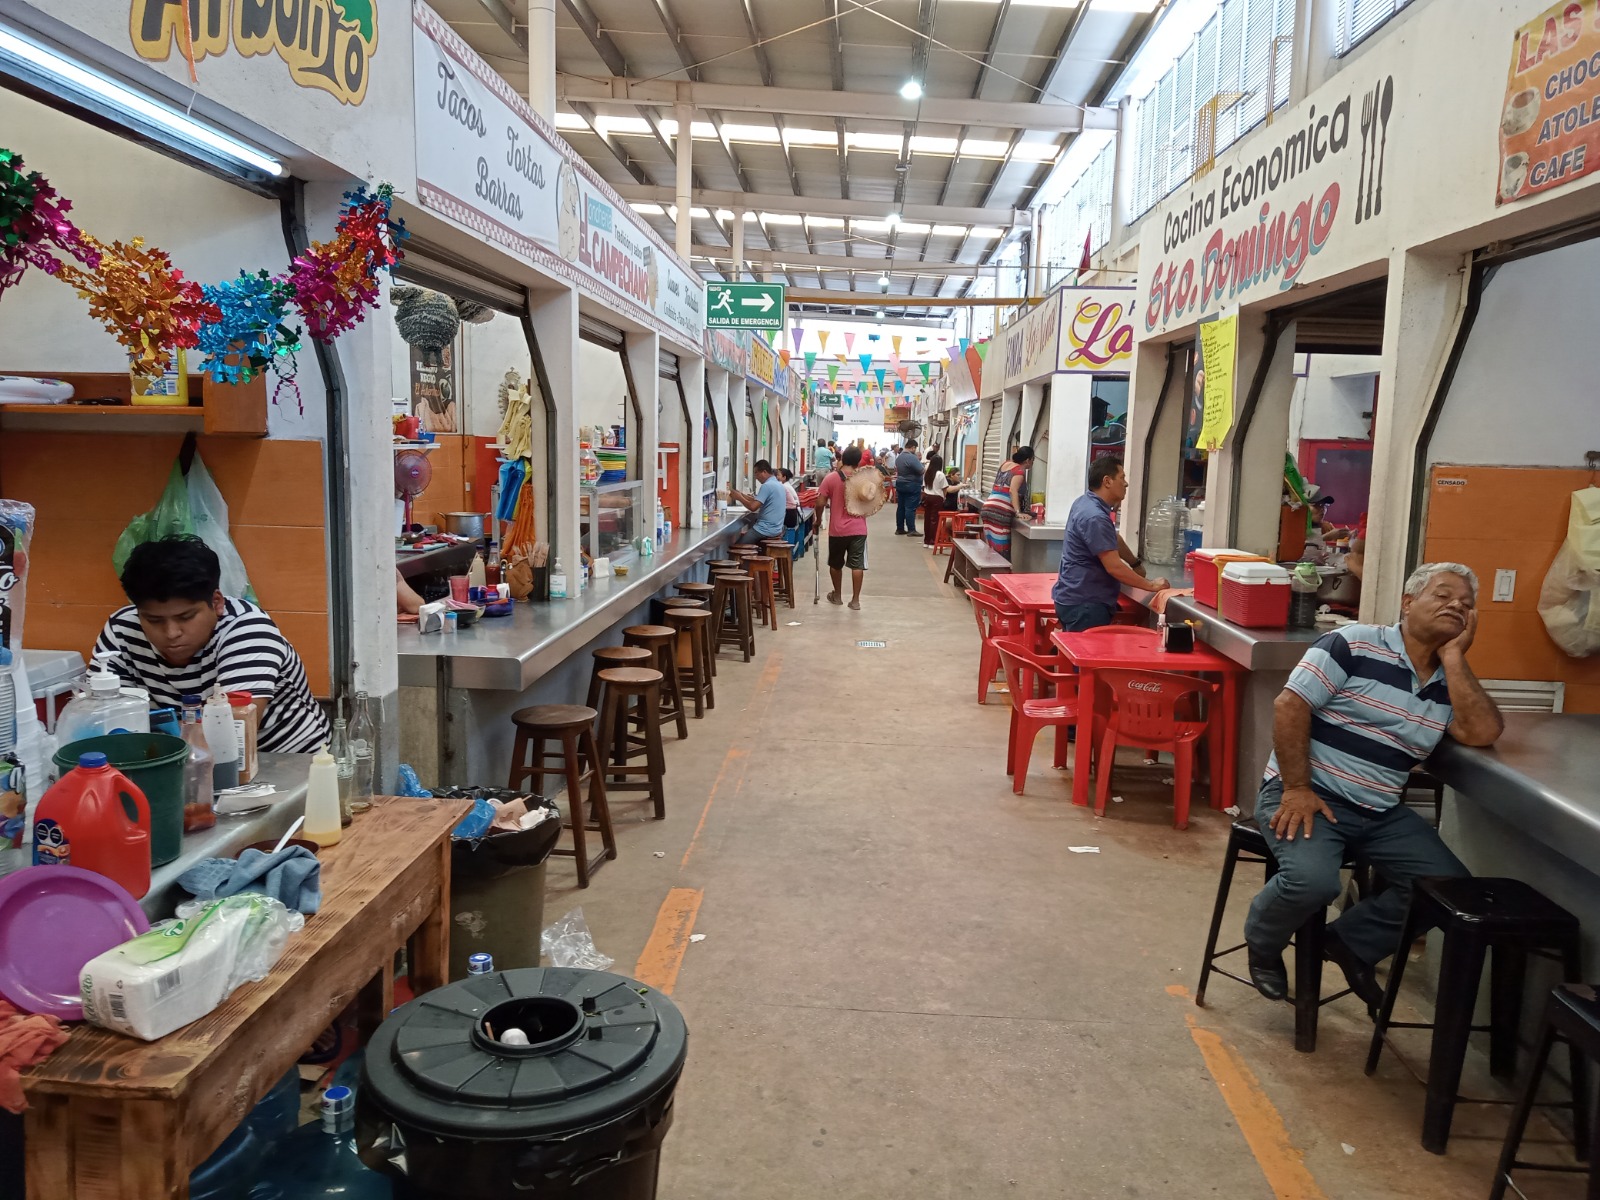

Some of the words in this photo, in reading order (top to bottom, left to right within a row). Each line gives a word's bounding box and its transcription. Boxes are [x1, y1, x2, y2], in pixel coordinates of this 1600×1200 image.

[1515, 3, 1583, 76] LAS
[1544, 51, 1600, 101] CHOC
[438, 61, 486, 138] Tacos
[506, 125, 546, 190] Tortas
[475, 156, 524, 221] Barras
[1164, 189, 1216, 254] Cocina
[1220, 95, 1351, 219] Economica
[1529, 145, 1587, 187] CAFE
[593, 231, 649, 306] CAMPECHANO
[1146, 258, 1198, 333] Sto.
[1201, 182, 1341, 312] Domingo
